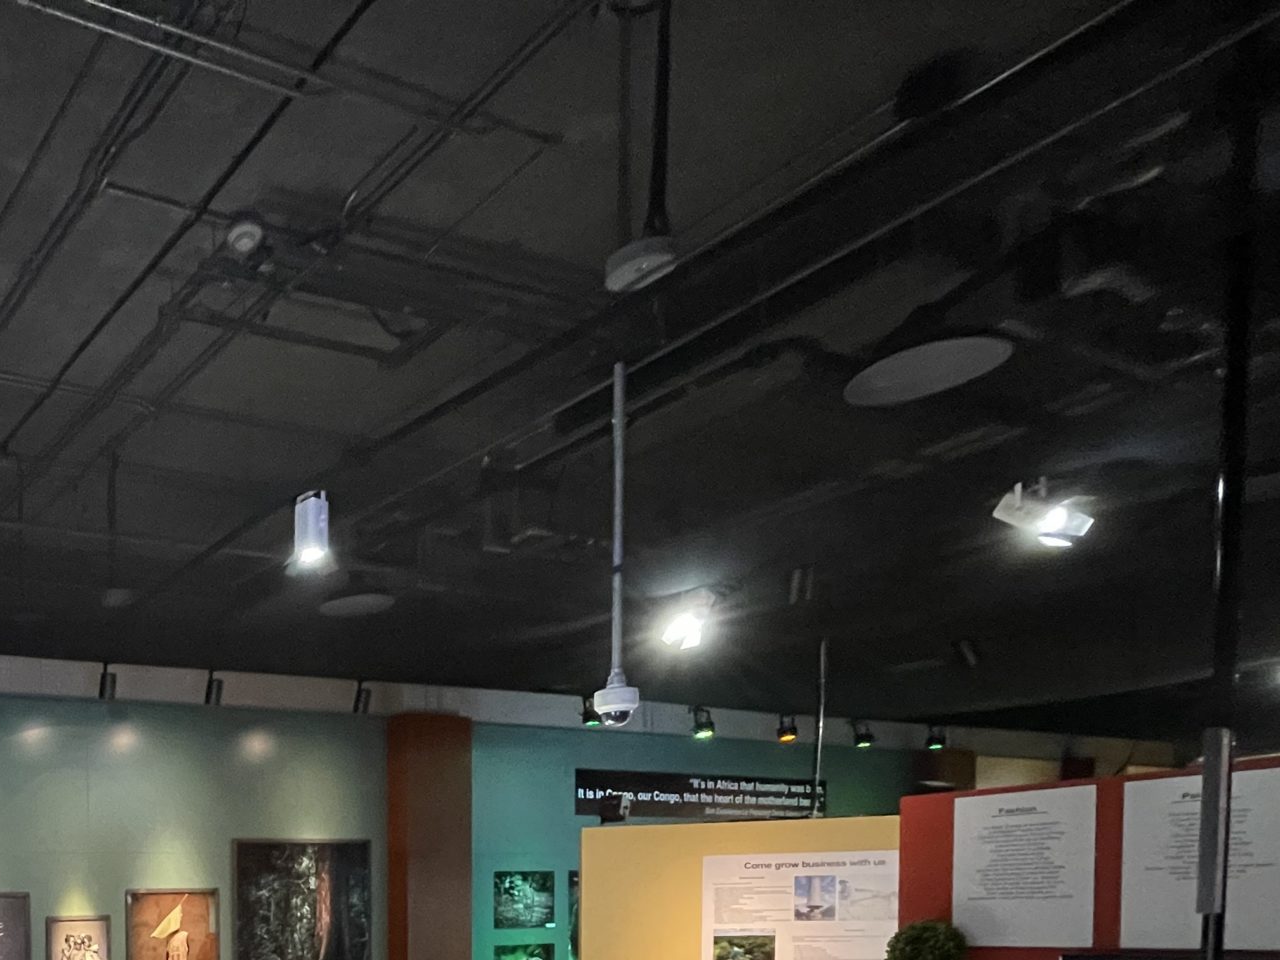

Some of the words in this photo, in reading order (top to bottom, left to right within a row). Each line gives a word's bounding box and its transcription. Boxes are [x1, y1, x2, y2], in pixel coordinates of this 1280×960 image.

[716, 780, 738, 791] Africa
[586, 789, 594, 799] is
[637, 792, 652, 801] our
[653, 790, 682, 804] Congo,
[683, 793, 699, 803] that
[700, 792, 713, 803] the
[714, 793, 733, 804] heart
[744, 861, 772, 870] Come
[774, 861, 799, 871] grow
[801, 859, 847, 868] business
[849, 859, 871, 868] with
[873, 858, 887, 866] us
